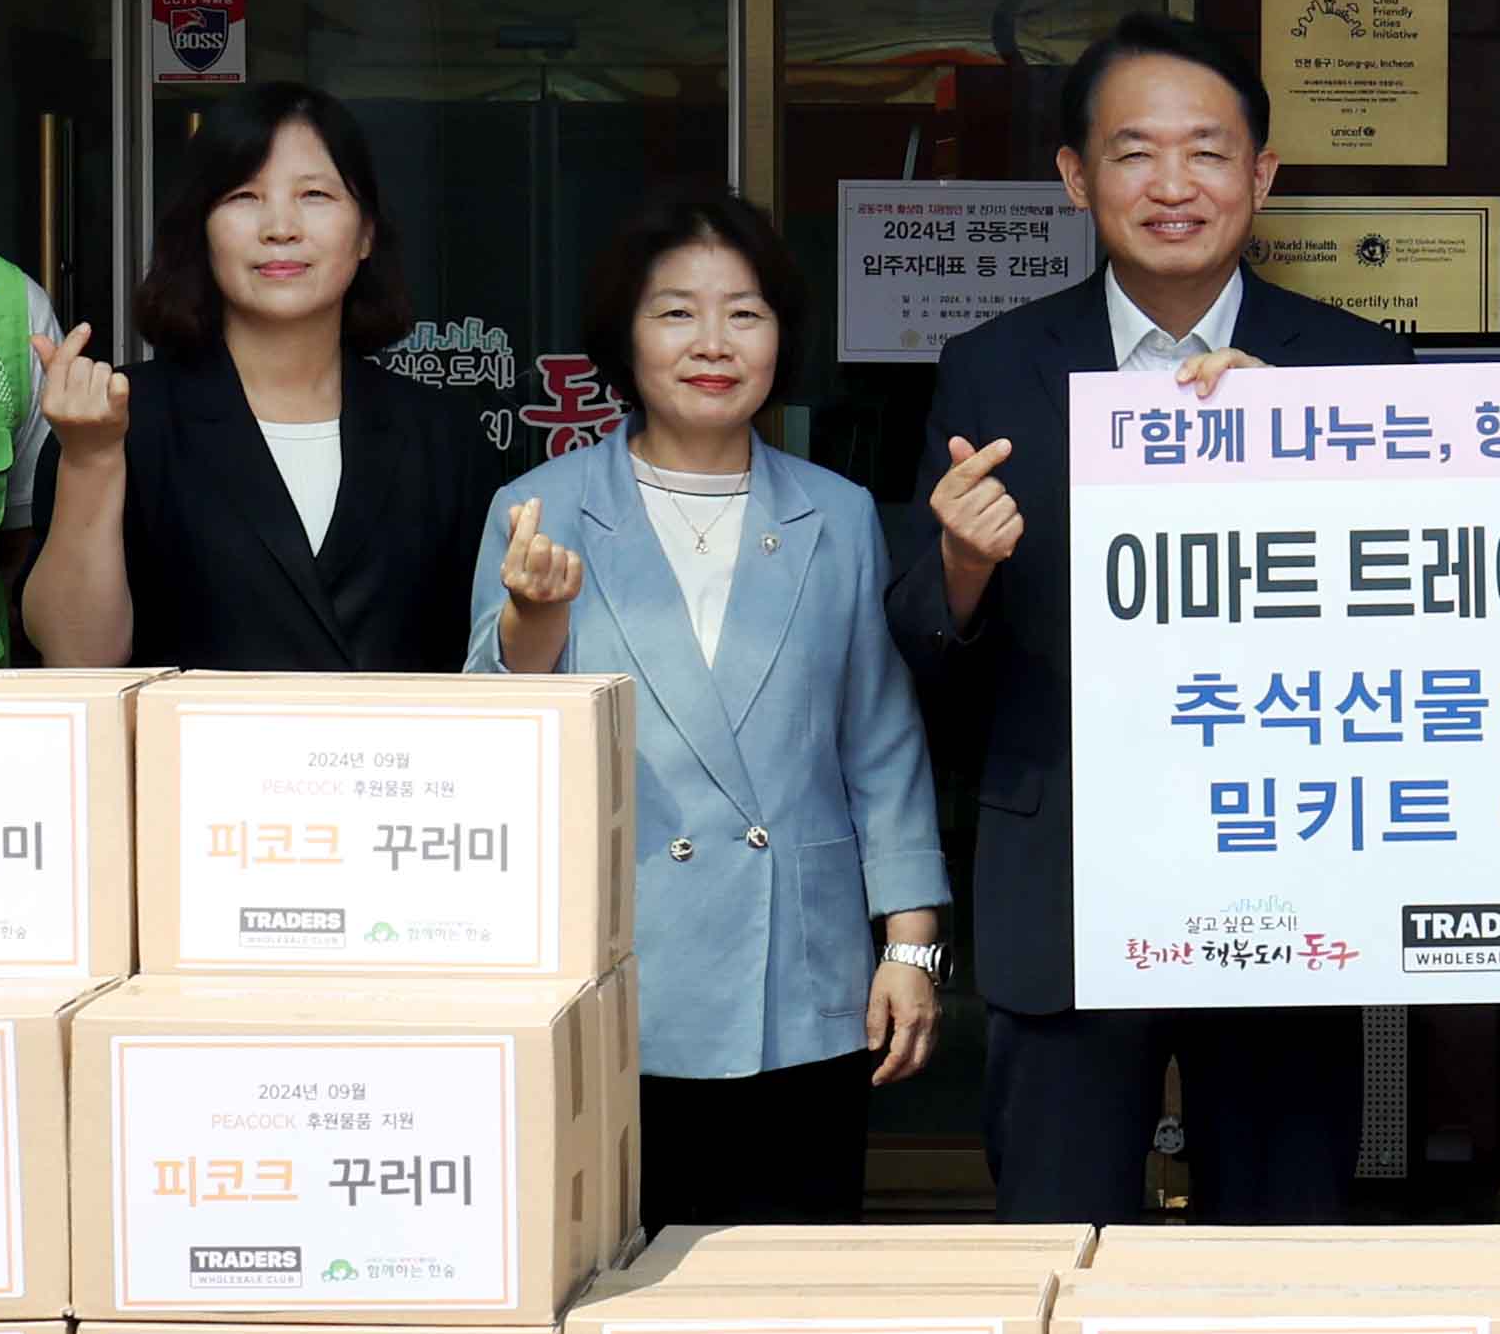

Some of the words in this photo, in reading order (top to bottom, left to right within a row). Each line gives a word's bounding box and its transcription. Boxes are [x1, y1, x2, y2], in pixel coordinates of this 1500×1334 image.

[1373, 7, 1412, 18] Friendly
[1373, 18, 1400, 28] Cities
[175, 33, 223, 49] BOSS
[1373, 30, 1418, 39] Initiative
[1331, 126, 1362, 136] unicef
[884, 220, 955, 240] 2024년
[966, 220, 1049, 243] 공동주택
[1274, 240, 1301, 251] World
[1306, 240, 1337, 251] Health
[863, 254, 966, 277] 입주자대표
[976, 255, 997, 276] 등
[1008, 255, 1069, 277] 간담회
[1273, 252, 1337, 264] Organization
[1347, 296, 1388, 310] certify
[1393, 296, 1418, 307] that
[519, 354, 629, 459] 동
[1269, 404, 1452, 467] 나누는,
[1105, 529, 1322, 624] 이마트
[1209, 776, 1457, 852] 밀키트
[1186, 917, 1218, 934] 살고
[1223, 916, 1255, 933] 싶은
[1259, 916, 1299, 931] 도시!
[1126, 938, 1194, 969] 활기찬
[1201, 938, 1292, 970] 행복도시
[1297, 934, 1359, 970] 동구
